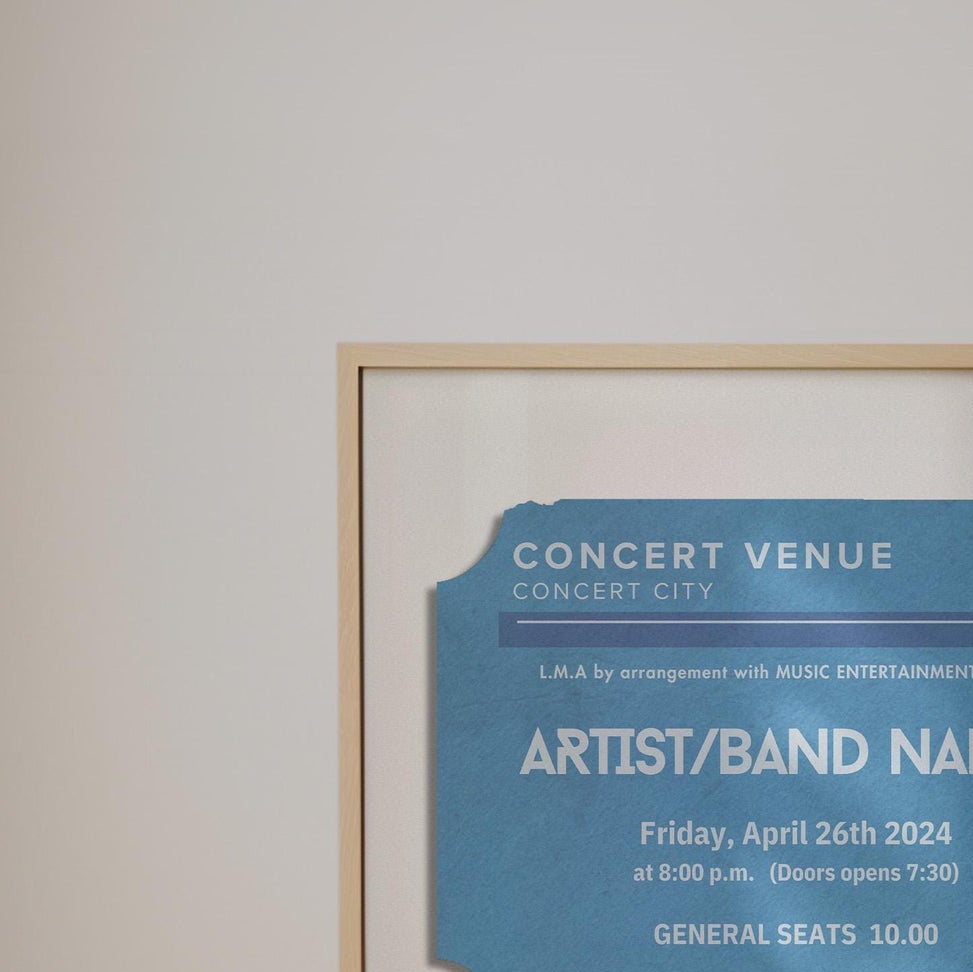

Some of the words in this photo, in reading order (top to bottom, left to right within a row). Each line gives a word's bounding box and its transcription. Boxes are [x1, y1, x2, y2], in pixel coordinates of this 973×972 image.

[514, 542, 723, 569] CONCERT
[744, 543, 891, 569] VENUE
[513, 583, 640, 599] CONCERT
[654, 583, 712, 599] CITY
[541, 665, 586, 678] L.M.A
[594, 664, 614, 683] by
[621, 667, 727, 683] arrangement
[734, 664, 768, 678] with
[776, 665, 829, 679] MUSIC
[520, 728, 868, 775] ARTIST/BAND
[641, 820, 733, 851] Friday,
[743, 820, 807, 851] April
[816, 821, 876, 845] 26th
[885, 821, 952, 845] 2024
[634, 865, 653, 881] at
[659, 864, 704, 881] 8:00
[710, 868, 753, 885] p.m.
[770, 863, 835, 884] (Doors
[841, 868, 900, 885] opens
[907, 863, 958, 884] 7:30)
[655, 924, 770, 944] GENERAL
[777, 924, 856, 944] SEATS
[871, 924, 938, 944] 10.00
